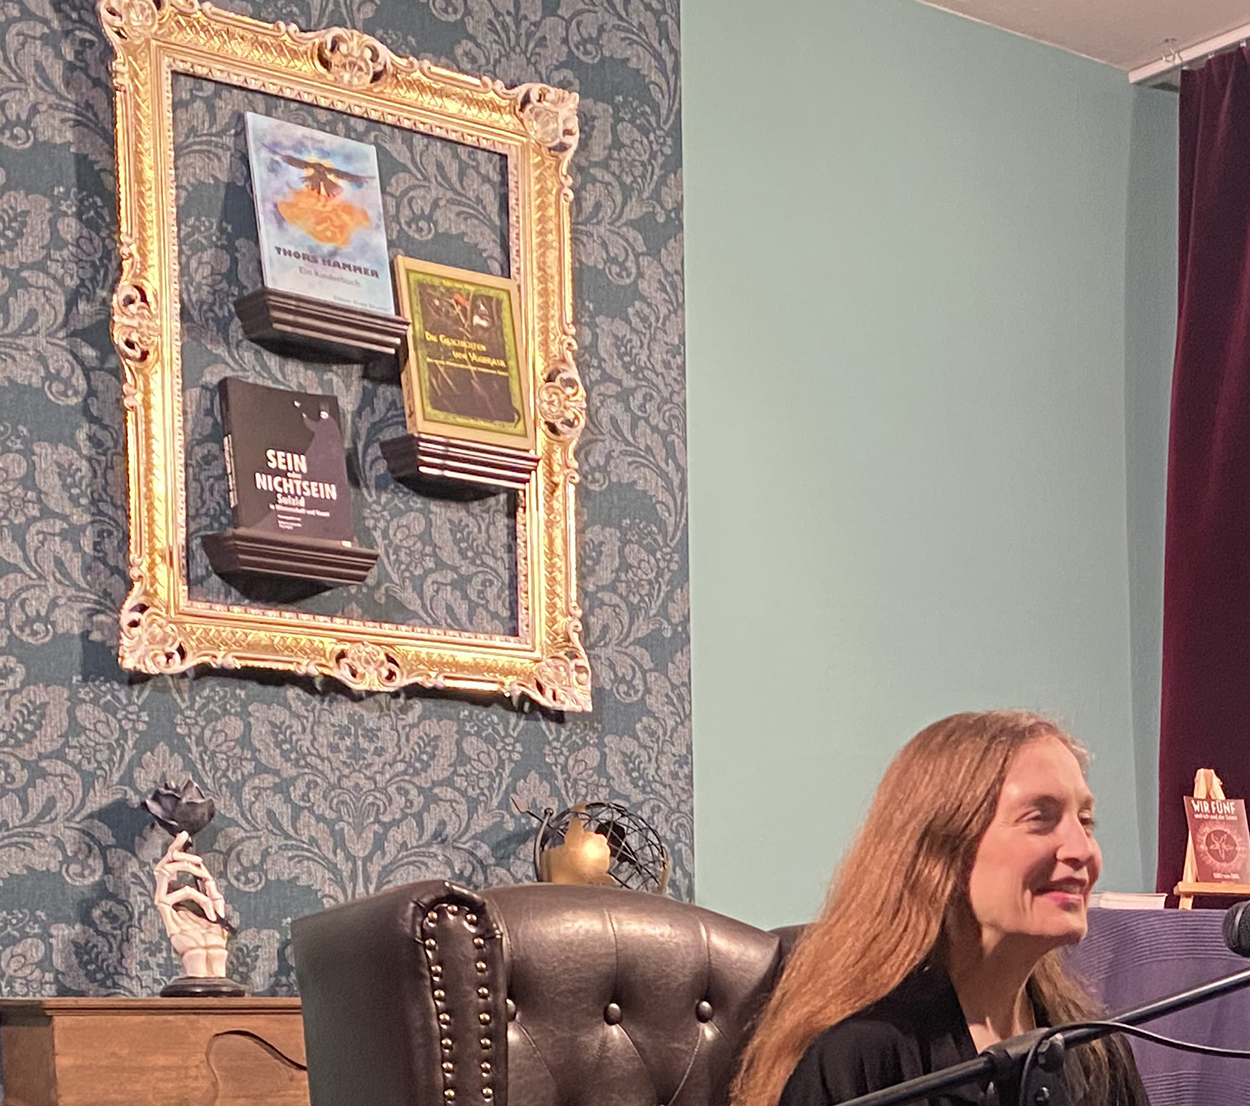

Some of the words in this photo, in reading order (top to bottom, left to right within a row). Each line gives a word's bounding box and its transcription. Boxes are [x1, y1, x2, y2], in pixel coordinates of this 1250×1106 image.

[275, 246, 318, 264] THORS
[322, 257, 379, 278] HAMMER
[266, 449, 308, 474] SEIN
[255, 472, 337, 500] NICHTSEIN
[1191, 799, 1209, 813] WIR
[1211, 799, 1236, 814] FÜNF
